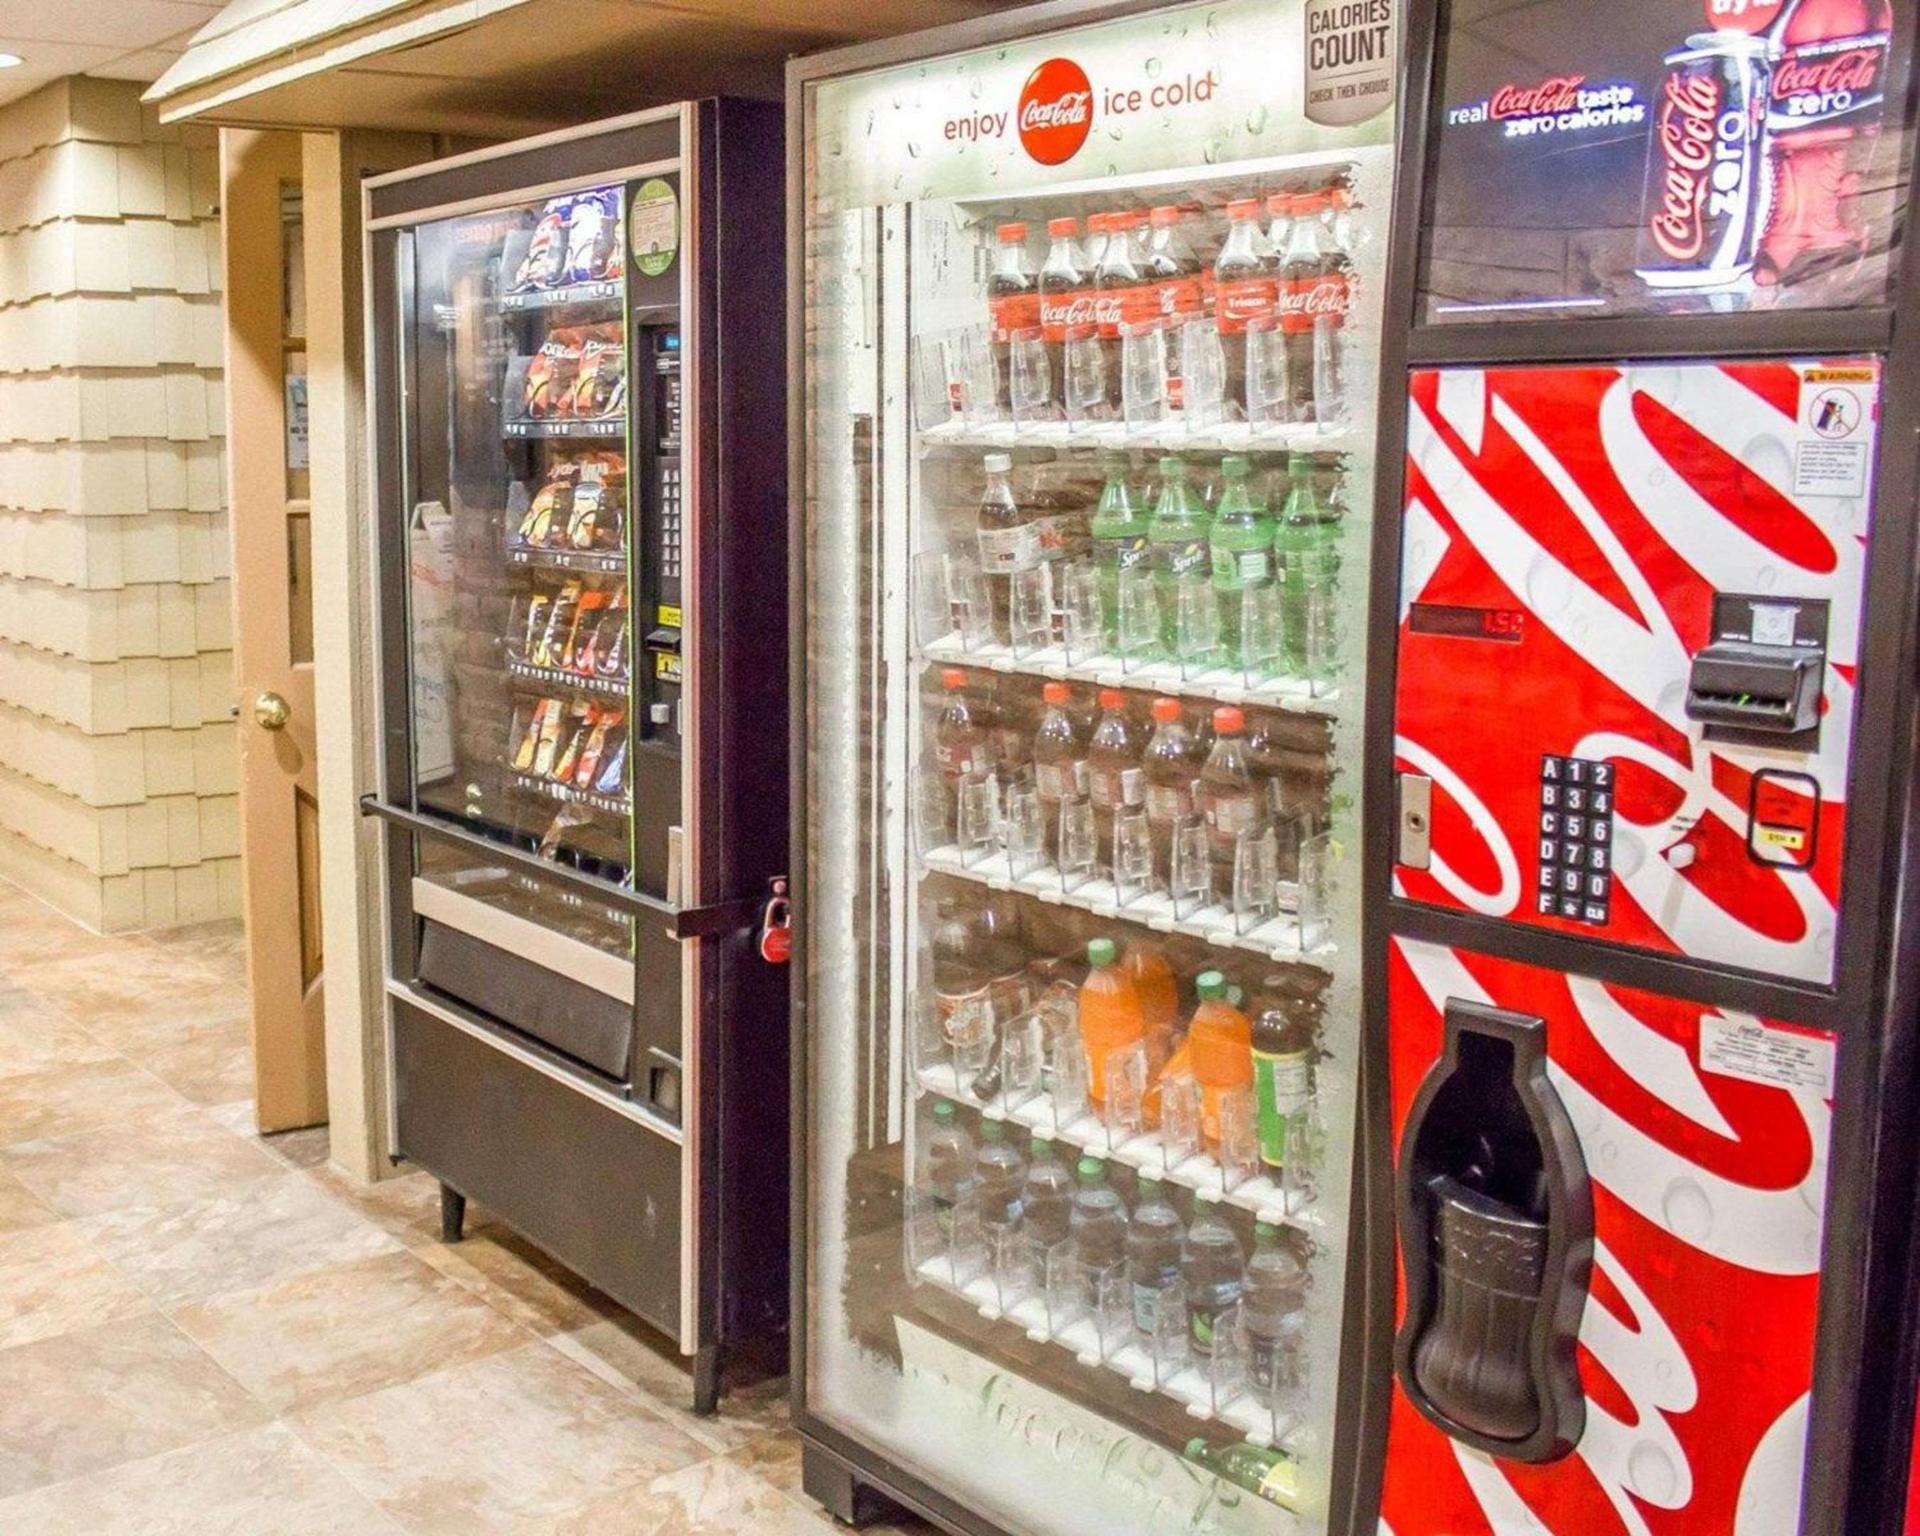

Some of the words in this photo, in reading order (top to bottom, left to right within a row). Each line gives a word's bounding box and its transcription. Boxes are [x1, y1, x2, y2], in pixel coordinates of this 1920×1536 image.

[1309, 0, 1390, 34] CALORIES
[1310, 25, 1390, 70] COUNT
[943, 109, 1008, 142] enjoy
[1104, 86, 1142, 116] ice
[1150, 71, 1216, 108] cold
[1337, 85, 1356, 99] THEN
[1449, 101, 1488, 126] real
[1577, 85, 1634, 109] taste
[1787, 92, 1852, 116] zero
[1504, 116, 1555, 137] zero
[1556, 104, 1645, 131] calories
[1543, 759, 1558, 779] A
[1570, 763, 1580, 781] 1
[1595, 767, 1608, 785] 2
[1543, 785, 1556, 804] B
[1569, 790, 1580, 808] 3
[1595, 794, 1607, 812] 4
[1542, 812, 1554, 832] C
[1568, 817, 1579, 836] 5
[1594, 822, 1606, 841] 6
[1541, 839, 1554, 859] D
[1566, 845, 1578, 863] 7
[1593, 850, 1605, 868] 8
[1540, 867, 1552, 886] E
[1565, 872, 1577, 891] 9
[1592, 877, 1604, 896] 0
[1539, 894, 1551, 913] F
